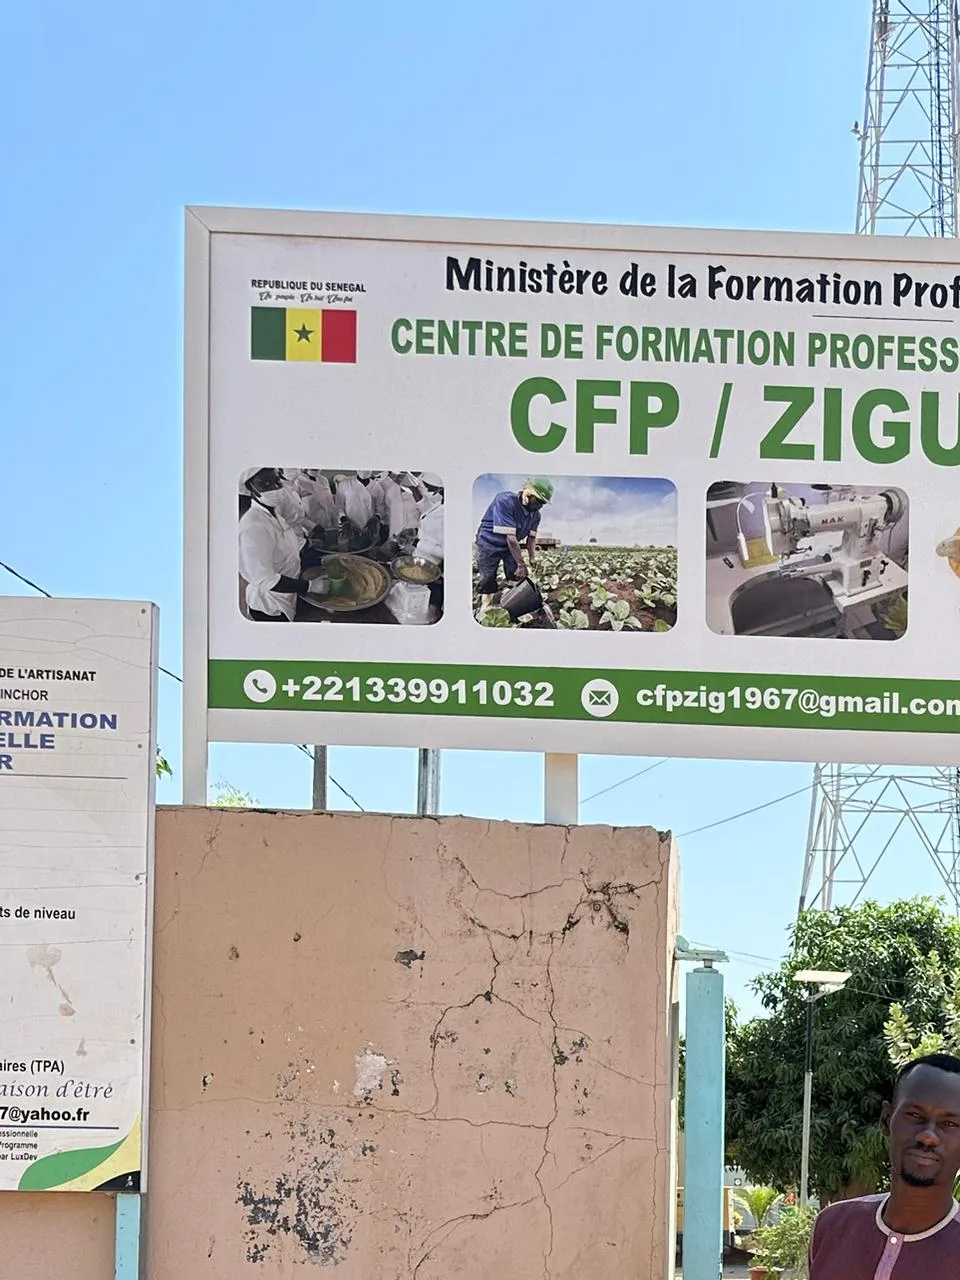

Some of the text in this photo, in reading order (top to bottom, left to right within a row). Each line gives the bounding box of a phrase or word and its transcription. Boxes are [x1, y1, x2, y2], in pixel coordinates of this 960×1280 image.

[251, 279, 367, 293] REPUBLIQUE DU SENEGAL
[446, 256, 608, 296] Ministère
[619, 262, 656, 298] de
[667, 264, 698, 300] la
[707, 265, 883, 306] Formation
[391, 318, 528, 358] CENTRE
[541, 323, 583, 359] DE
[596, 324, 795, 366] FORMATION
[510, 376, 680, 456] CFP
[709, 382, 733, 459] /
[18, 668, 96, 681] L'ARTISANAT
[282, 675, 554, 707] +221339911032
[15, 906, 30, 918] de
[34, 907, 76, 920] niveau
[31, 1060, 65, 1075] (TPA)
[56, 1079, 113, 1099] d'être
[0, 1106, 90, 1123] 7@yahoo.fr
